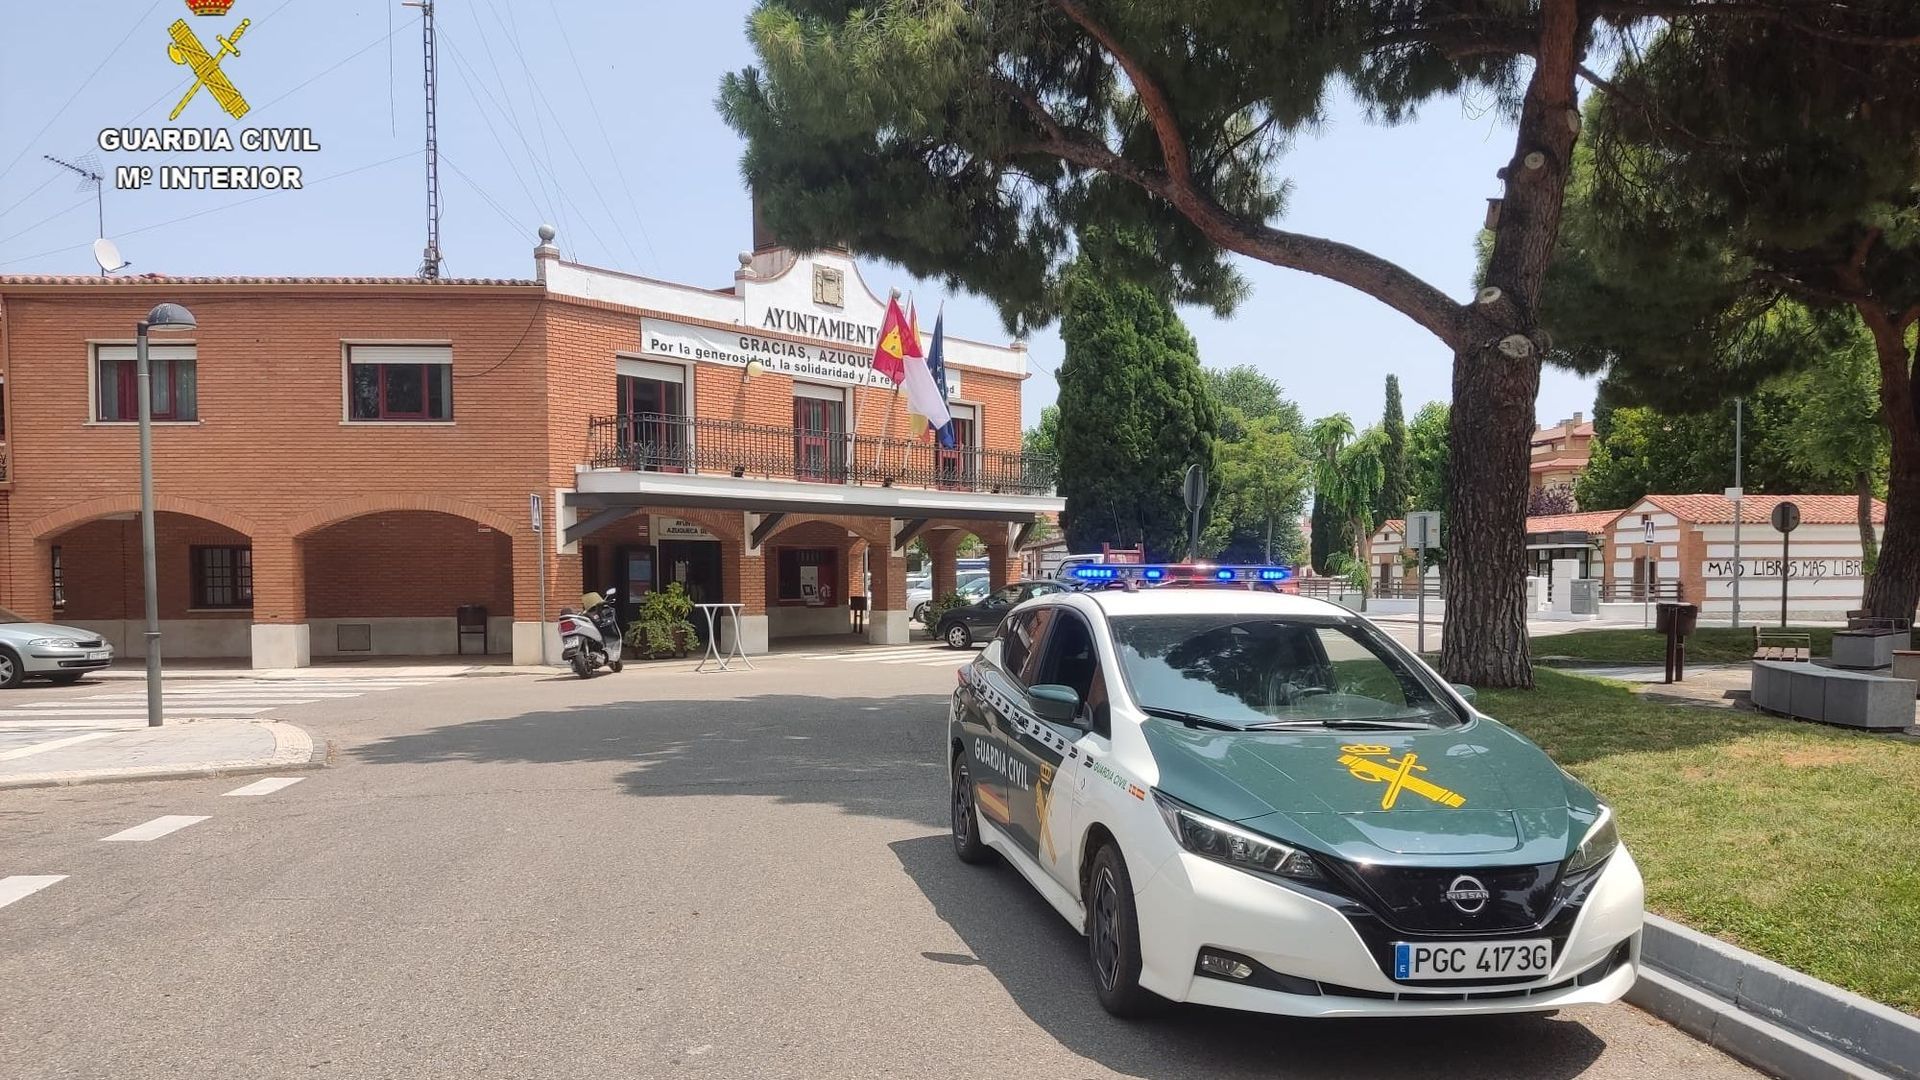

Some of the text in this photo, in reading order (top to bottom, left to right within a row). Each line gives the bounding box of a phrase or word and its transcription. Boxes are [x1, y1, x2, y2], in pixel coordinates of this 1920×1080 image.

[763, 306, 880, 345] AYUNTAMIENT
[651, 338, 674, 352] Por
[679, 342, 690, 355] la
[780, 359, 790, 370] la
[794, 362, 855, 380] solidaridad
[858, 373, 864, 382] y
[739, 336, 873, 369] GRACIAS, AZUQUE
[974, 738, 1029, 791] GUARDIA CIVIL
[1093, 761, 1128, 790] GUARDIA CIVIL
[1446, 890, 1490, 900] NISSAN
[1400, 964, 1406, 973] E
[1414, 945, 1547, 973] PGC 4173G
